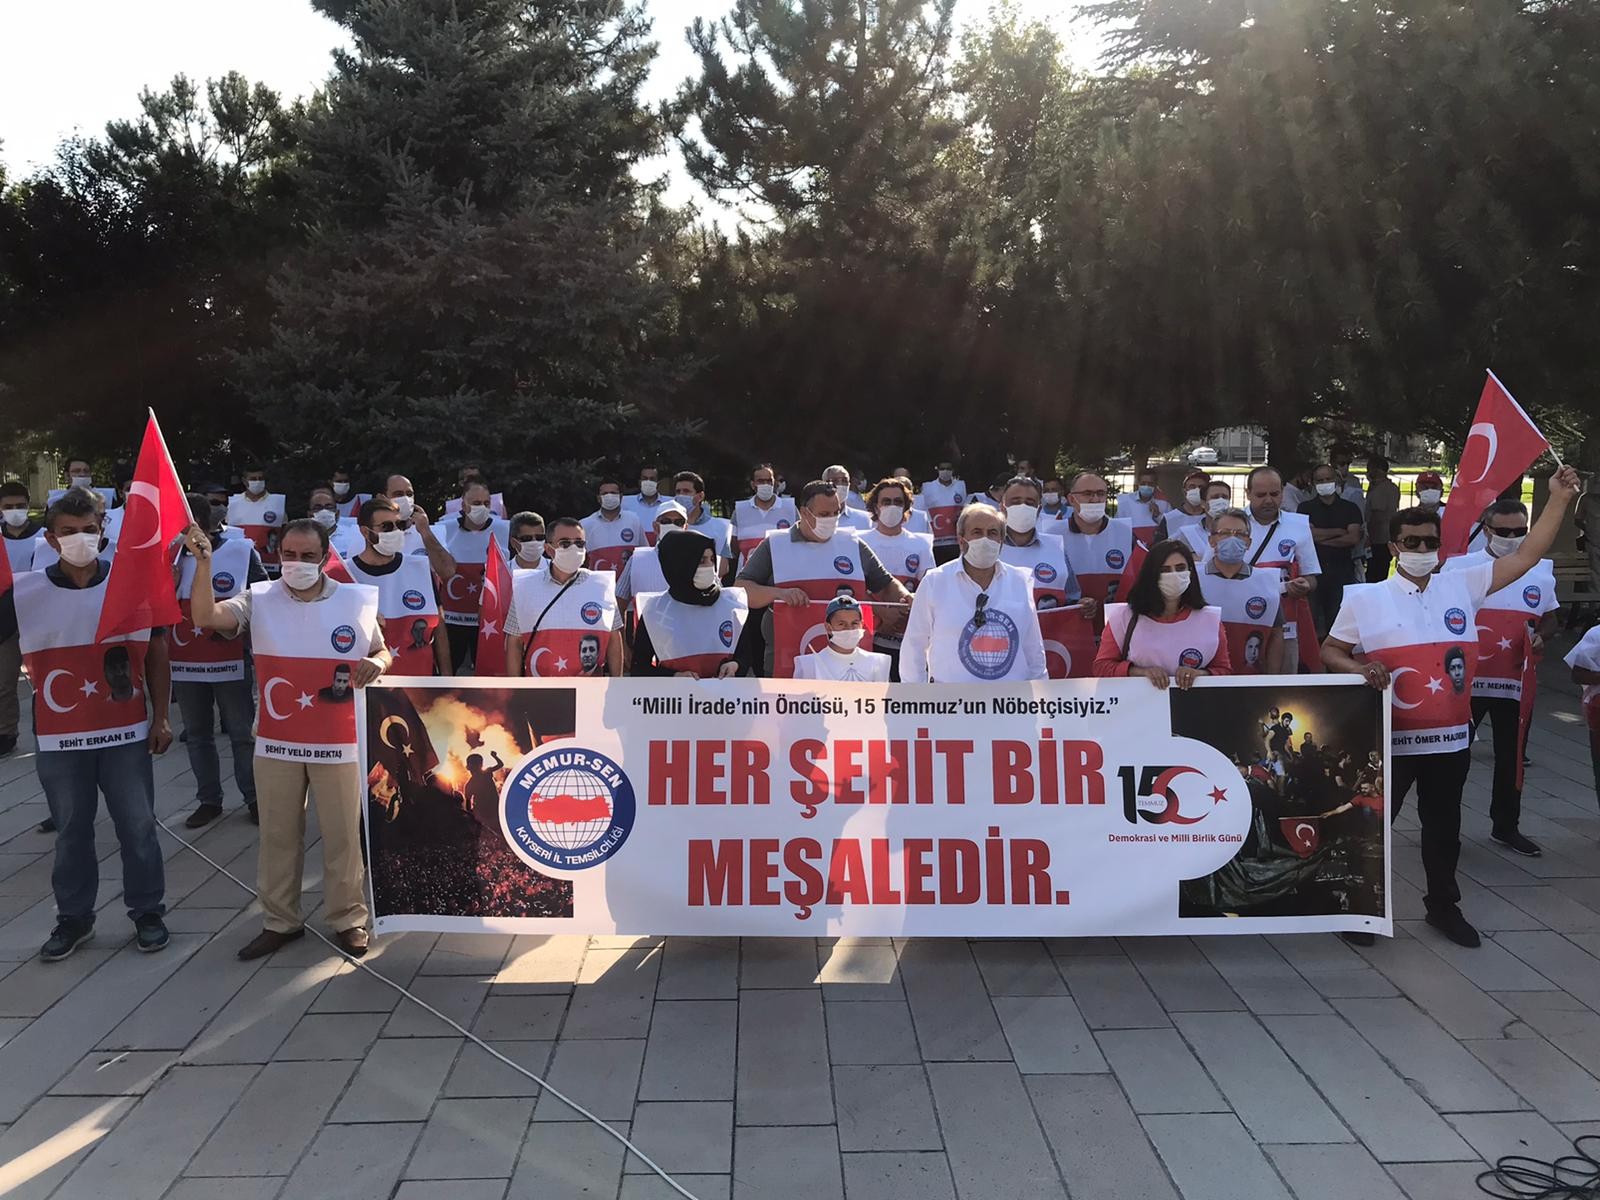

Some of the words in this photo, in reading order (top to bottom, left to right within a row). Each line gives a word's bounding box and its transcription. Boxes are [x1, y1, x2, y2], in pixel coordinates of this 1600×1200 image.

[775, 694, 849, 717] Öncüsü,
[854, 698, 876, 714] 15
[59, 737, 84, 749] ŞEHİT
[86, 733, 122, 746] ERKAN
[124, 731, 137, 740] ER
[265, 744, 286, 755] ŞEHİT
[287, 747, 313, 758] VELİD
[314, 749, 343, 759] BEKTAŞ
[1391, 736, 1414, 746] EHİT
[1415, 734, 1442, 744] ÖMER
[518, 752, 624, 790] MEMUR-SEN
[648, 739, 771, 805] HER
[789, 728, 974, 819] ŞEHİT
[991, 728, 1106, 805] BİR
[1117, 765, 1180, 825] 15
[515, 826, 552, 860] KAYSERİ
[553, 852, 563, 864] İL
[565, 825, 625, 865] TEMSİLCİLİĞİ
[1108, 833, 1157, 843] Demokrasi
[1170, 833, 1190, 843] Milli
[1192, 833, 1217, 843] Birlik
[1218, 833, 1242, 843] Günü
[688, 826, 1071, 920] MEŞALEDİR.
